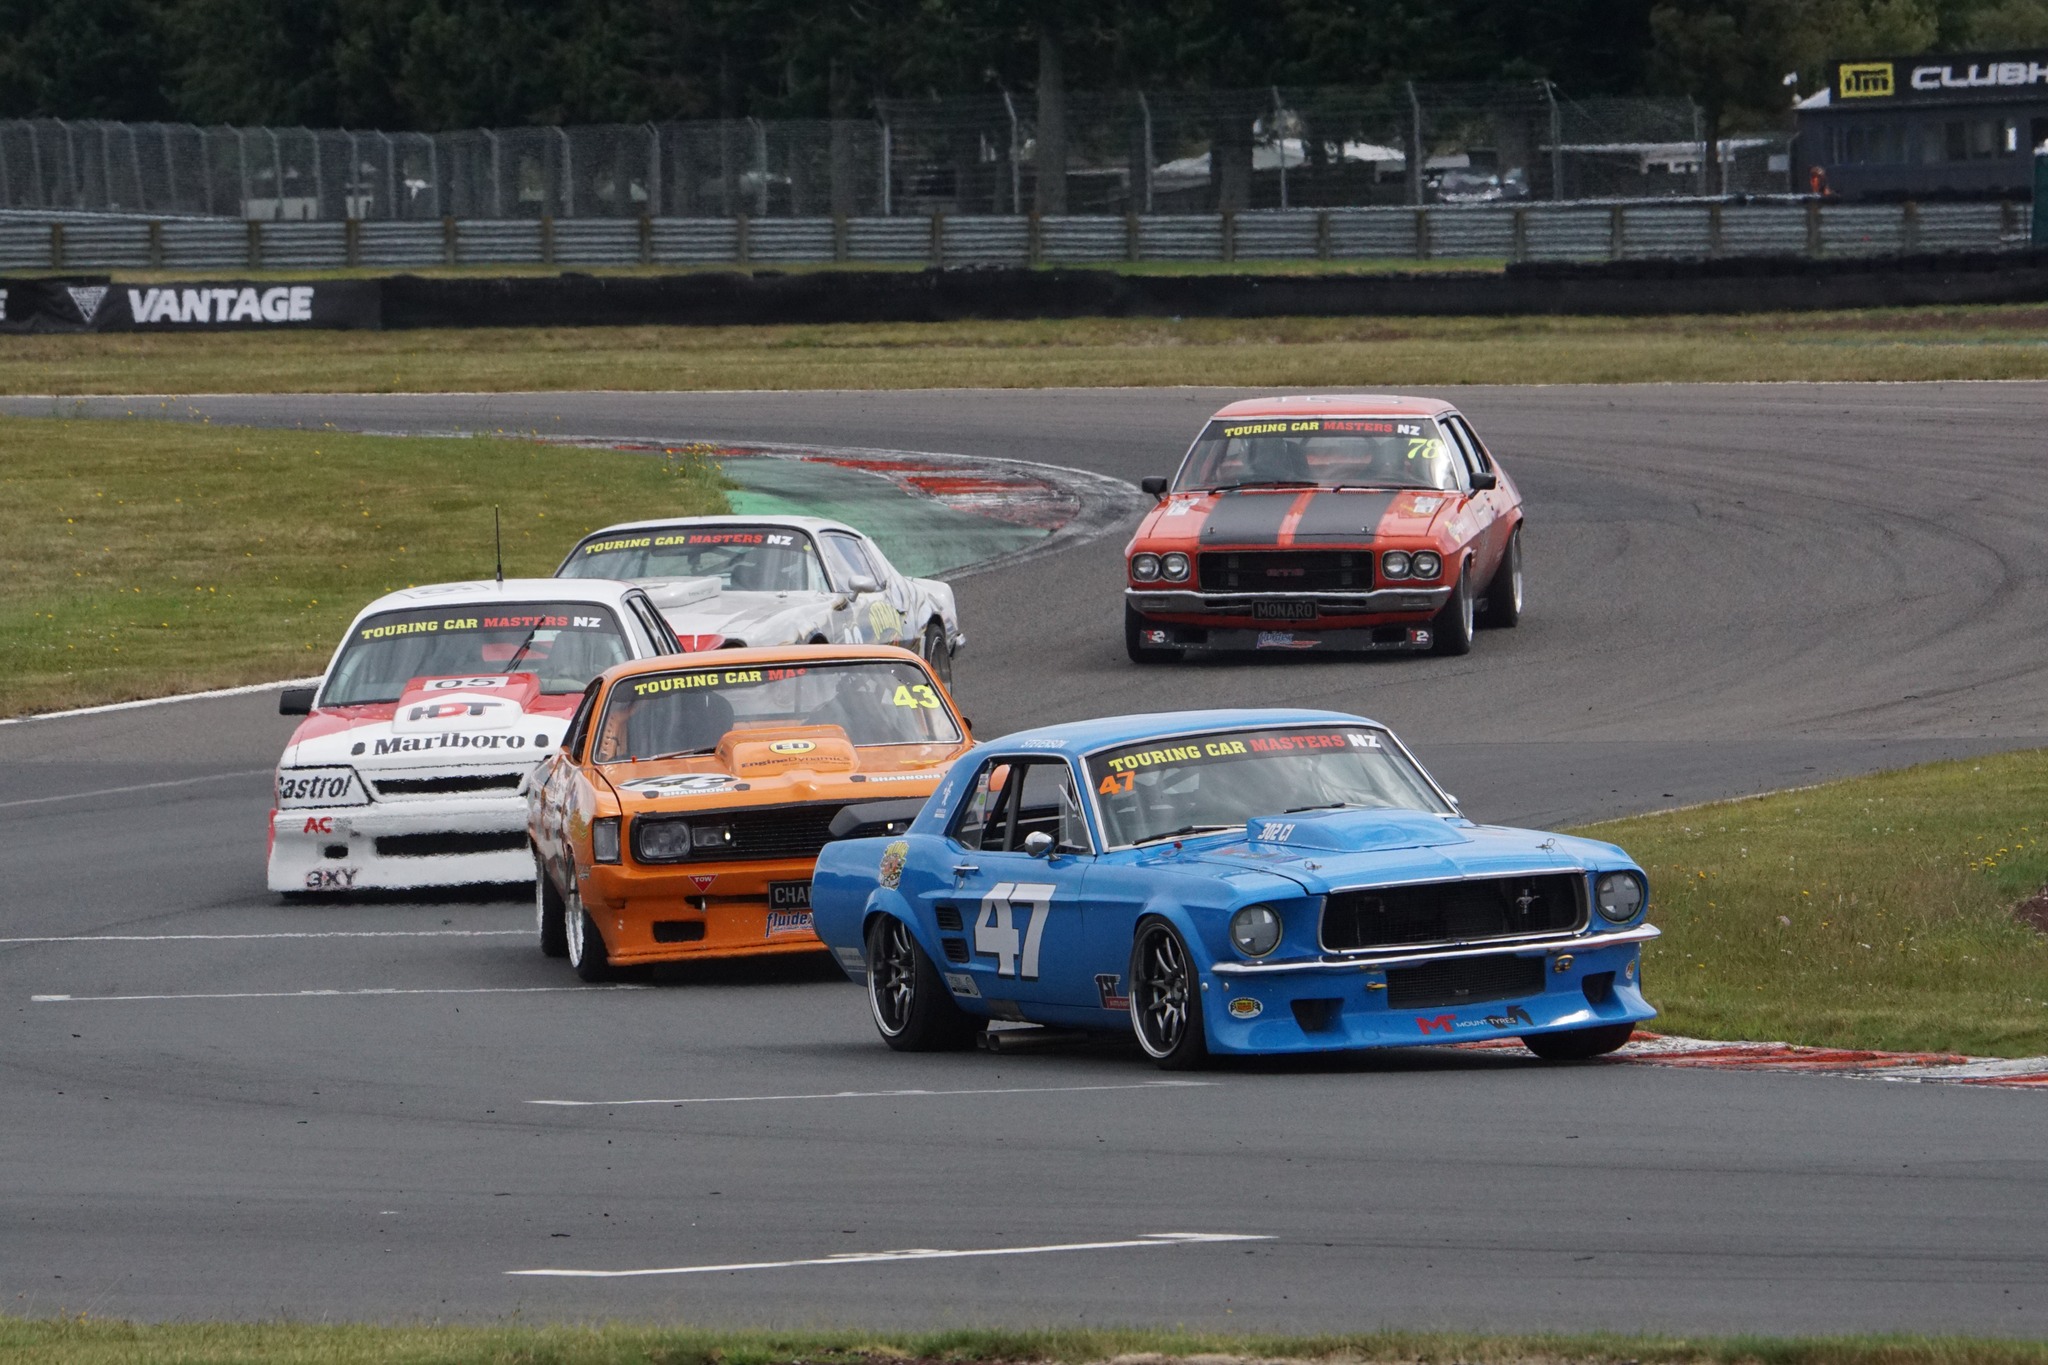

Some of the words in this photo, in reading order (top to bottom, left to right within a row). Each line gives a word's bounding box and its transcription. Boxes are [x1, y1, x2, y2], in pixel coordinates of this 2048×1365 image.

[127, 286, 314, 323] VANTAGE
[1224, 423, 1287, 437] TOURING
[1291, 422, 1319, 431] CAR
[1323, 421, 1393, 432] MASTERS
[1397, 424, 1421, 436] NZ
[585, 538, 650, 554] TOURING
[655, 536, 685, 545] CAR
[689, 534, 763, 545] MASTERS
[767, 534, 794, 546] NZ
[1257, 601, 1313, 618] MONARO
[362, 621, 438, 640] TOURING
[444, 618, 478, 630] CAR
[484, 616, 568, 628] MASTERS
[573, 616, 602, 628] NZ
[435, 678, 496, 689] 05
[634, 673, 719, 695] TOURING
[725, 671, 762, 684] CAR
[893, 684, 940, 709] 43
[409, 702, 502, 721] HDT
[374, 733, 525, 755] Marlboro
[1108, 745, 1201, 772] TOURING
[1205, 741, 1247, 757] CAR
[1249, 734, 1345, 752] MASTERS
[1347, 733, 1381, 748] NZ
[870, 773, 942, 783] SHANNONS
[1099, 771, 1136, 795] 47
[662, 785, 733, 797] SHANNONS
[303, 817, 332, 833] AC
[1258, 822, 1282, 841] 302
[974, 882, 1056, 982] 47
[1456, 1019, 1487, 1028] MOUNT
[1489, 1017, 1516, 1025] TYRES
